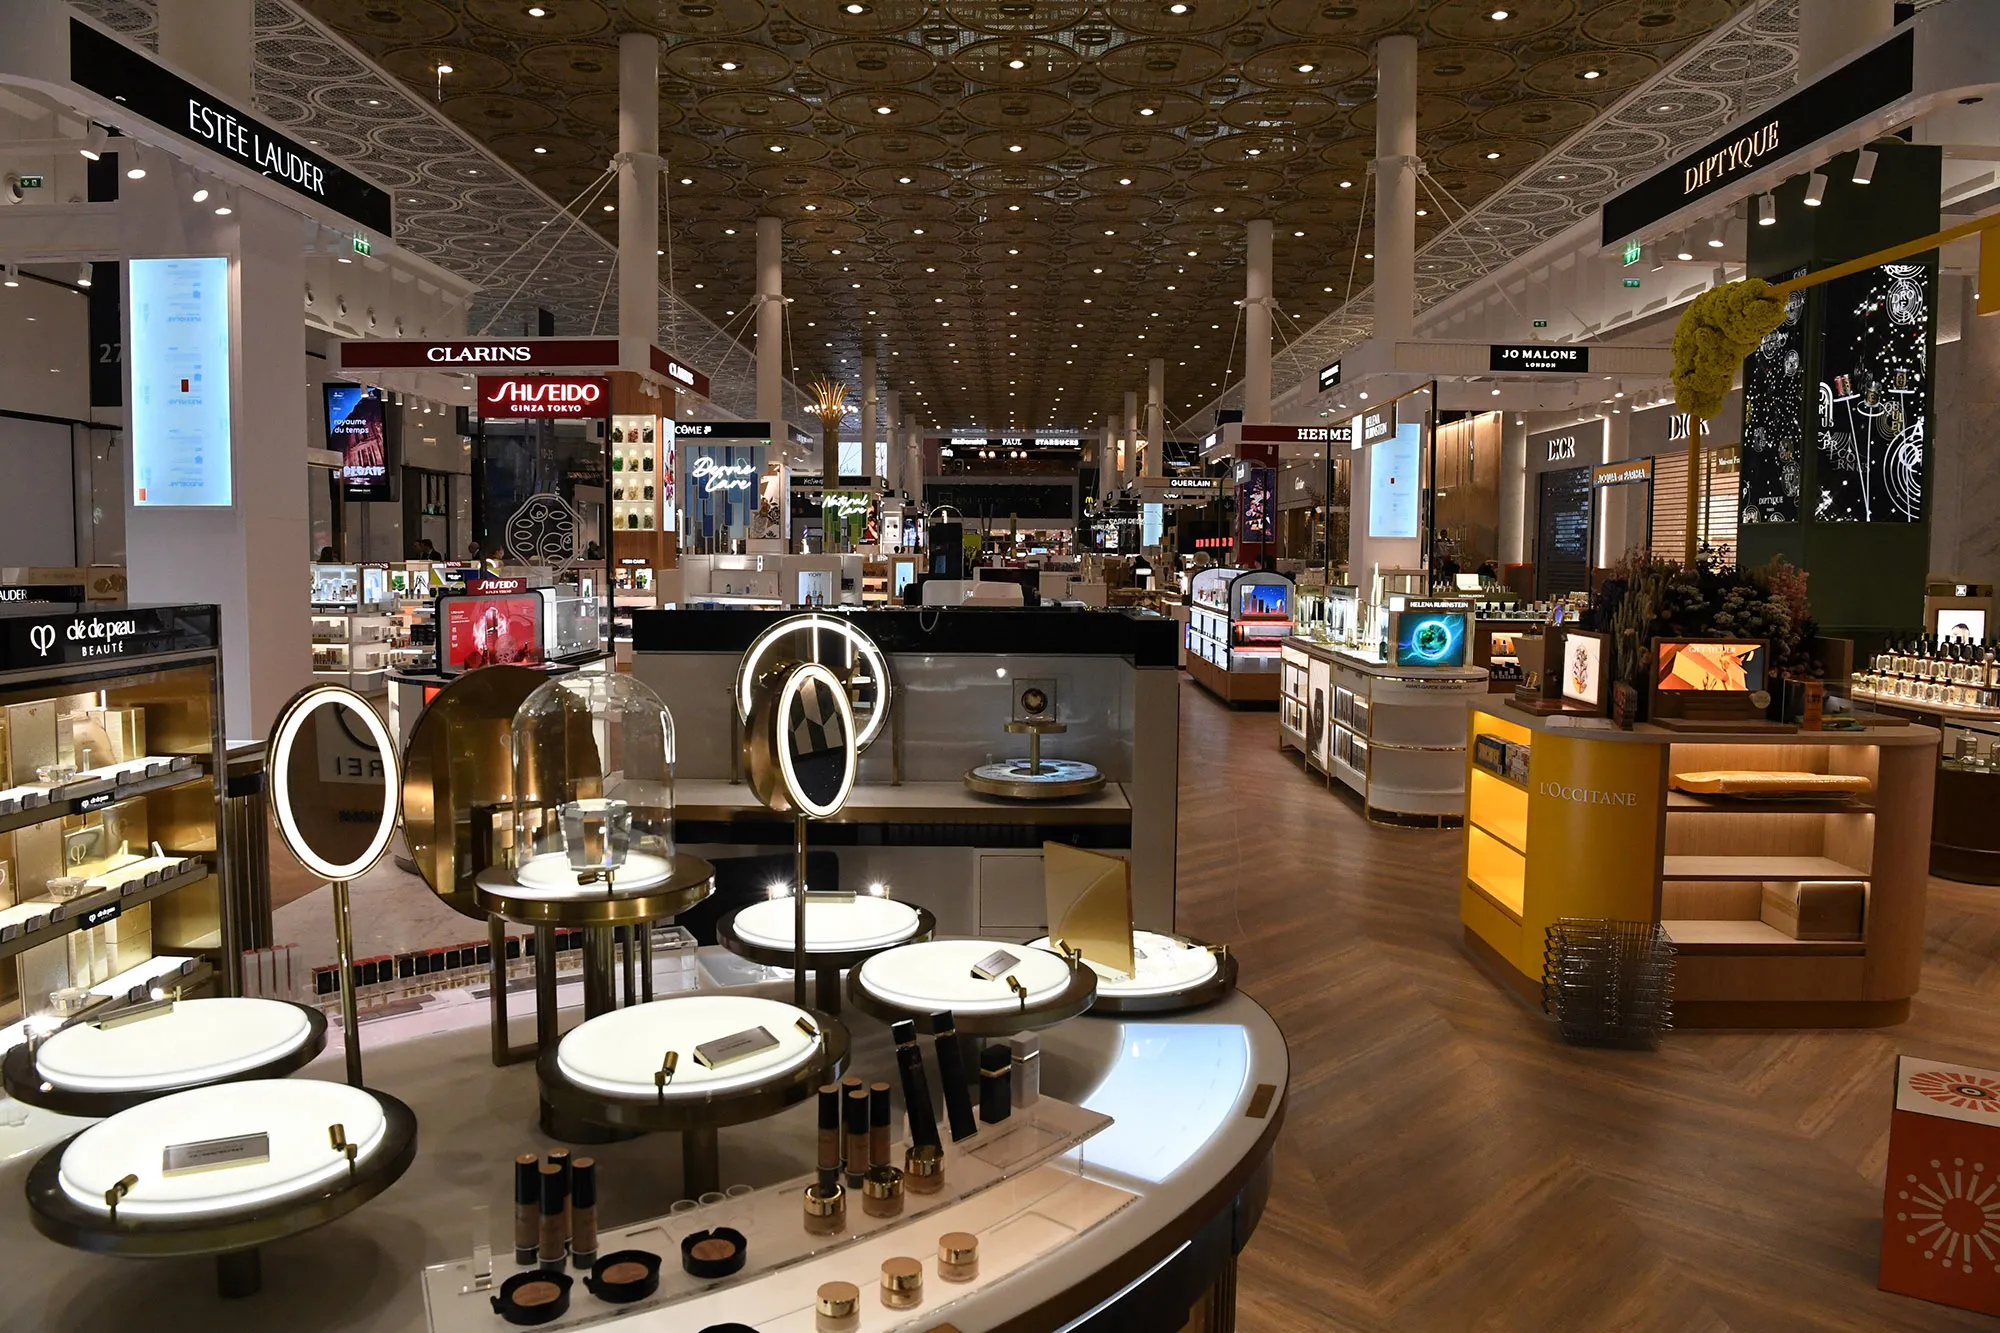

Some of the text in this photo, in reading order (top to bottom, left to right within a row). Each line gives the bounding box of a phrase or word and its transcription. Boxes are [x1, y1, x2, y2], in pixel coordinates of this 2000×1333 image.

[255, 134, 325, 196] LAUDER
[1684, 120, 1779, 195] DIPTYQUE
[100, 343, 121, 363] 27
[427, 346, 531, 362] CLARINS
[1502, 349, 1577, 360] JO MALONE
[487, 381, 600, 403] SHISEIDO
[510, 404, 581, 412] GINZA TOKYO
[333, 418, 367, 427] royaume
[334, 426, 369, 435] du temps
[675, 424, 702, 435] CÔME
[1002, 438, 1023, 446] PAUL
[1297, 427, 1352, 441] HERMÈ
[1547, 436, 1576, 461] DIOR
[692, 456, 756, 479] Derma
[705, 475, 752, 493] Care
[1171, 479, 1211, 487] GUERLAIN
[477, 580, 518, 590] SHISEIDO
[0, 589, 27, 600] AUDER
[66, 617, 136, 642] clé de peau
[82, 640, 124, 657] BEAUTÉ
[1540, 782, 1637, 806] L'OCCITANE
